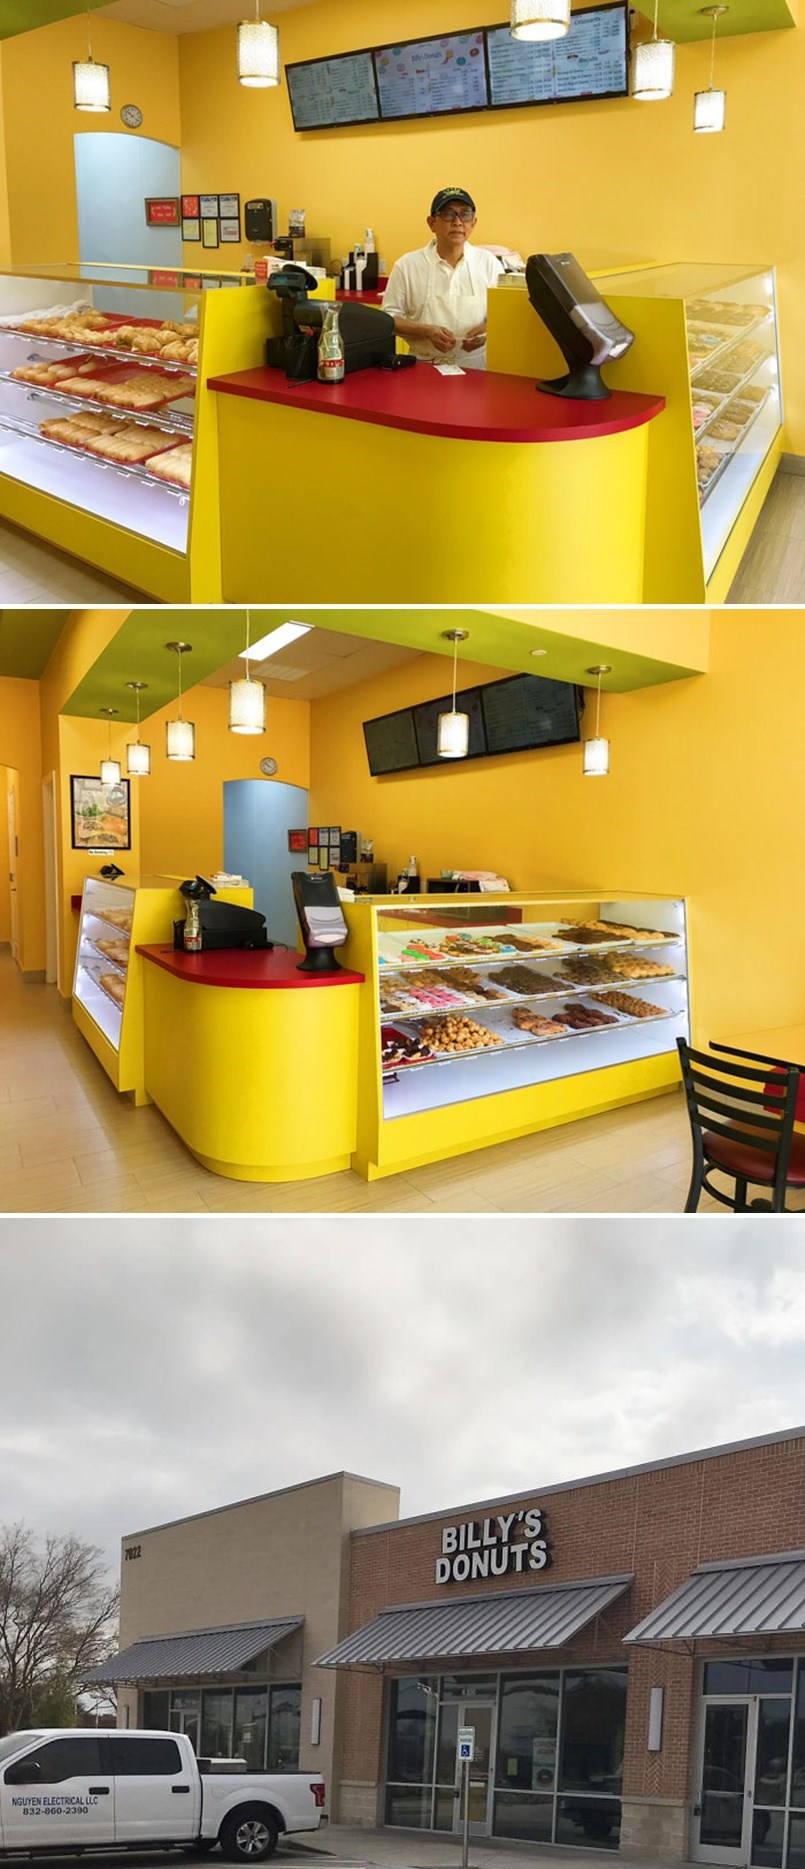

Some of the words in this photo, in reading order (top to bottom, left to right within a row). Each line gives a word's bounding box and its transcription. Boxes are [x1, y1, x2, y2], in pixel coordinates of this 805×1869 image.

[442, 1508, 542, 1555] BILLY'S
[435, 1540, 547, 1585] DONUTS
[12, 1797, 41, 1806] NGUYEN
[43, 1797, 84, 1806] ELECTRICAL
[86, 1796, 98, 1805] LLC
[23, 1807, 89, 1815] 832-860-2390
